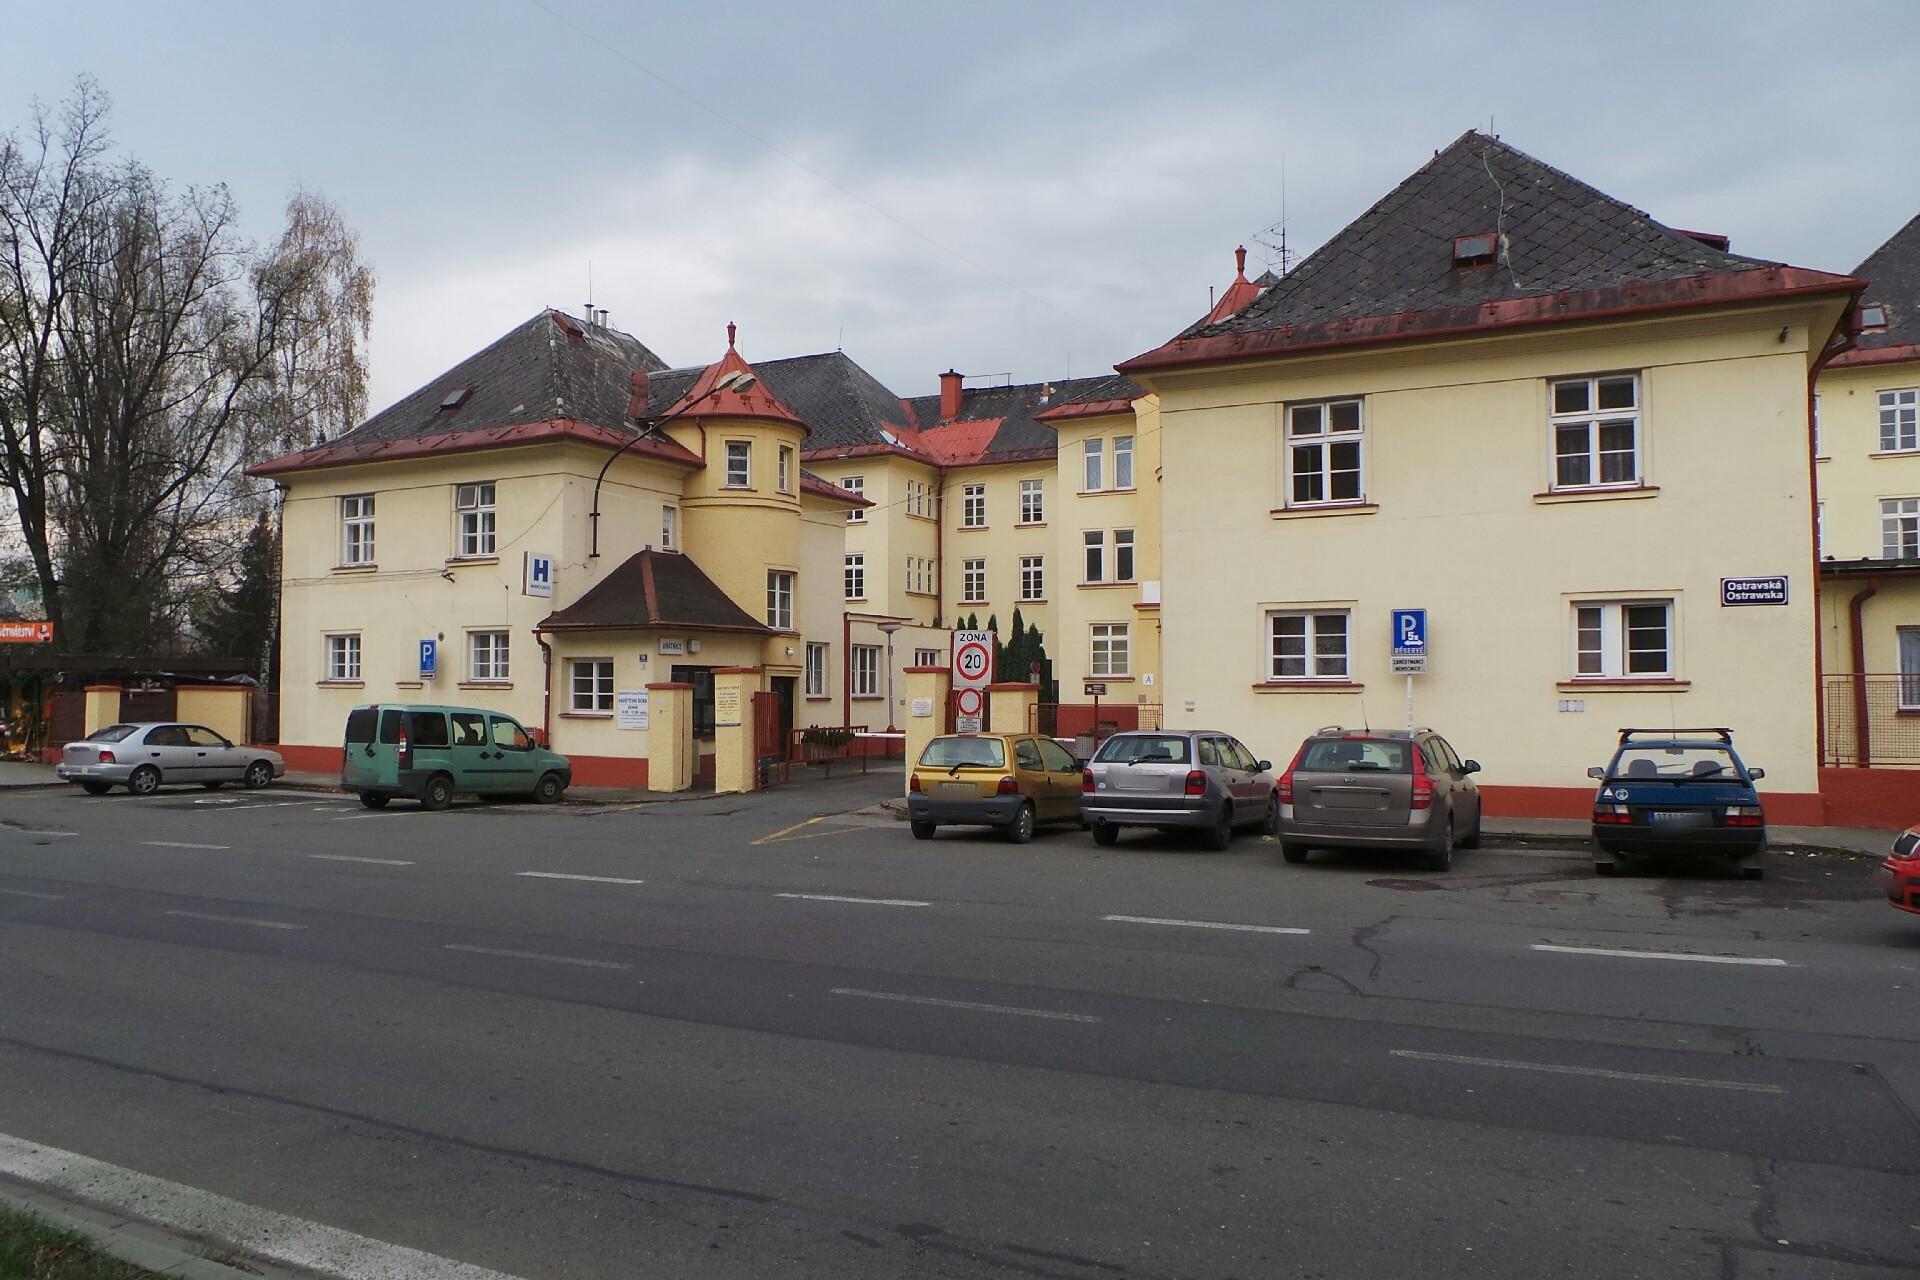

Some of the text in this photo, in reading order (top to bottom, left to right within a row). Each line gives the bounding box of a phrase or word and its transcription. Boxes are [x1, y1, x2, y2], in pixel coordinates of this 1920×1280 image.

[533, 558, 549, 583] H
[1727, 580, 1782, 591] Ostravská
[1726, 590, 1784, 600] Ostrawska
[1400, 615, 1417, 641] P
[1407, 631, 1419, 641] 5x
[423, 644, 432, 662] P
[965, 654, 981, 669] 20
[1145, 675, 1152, 684] A
